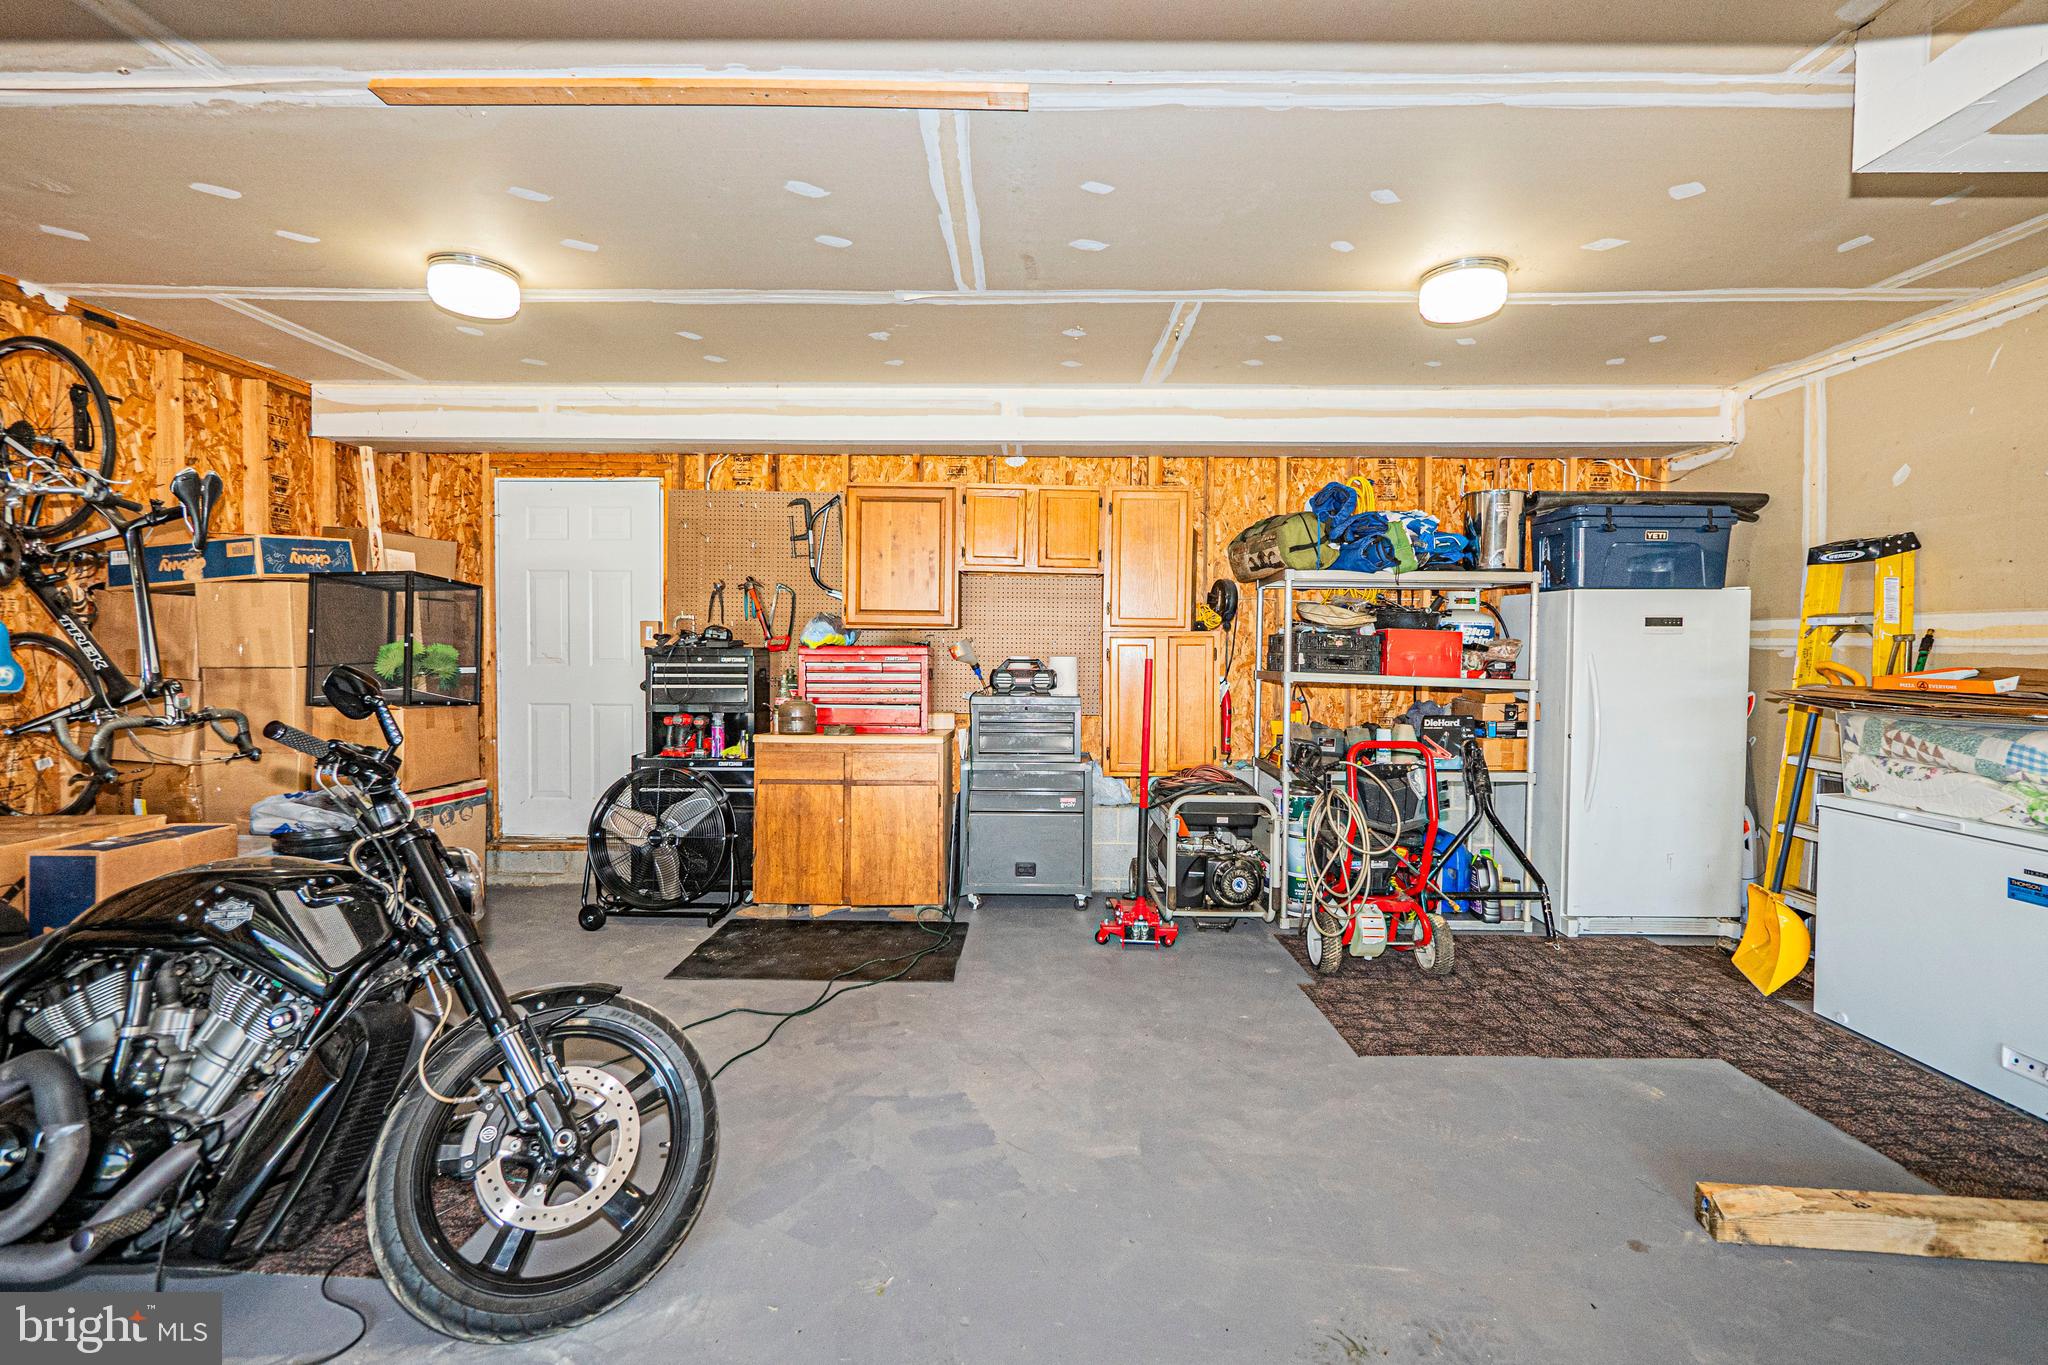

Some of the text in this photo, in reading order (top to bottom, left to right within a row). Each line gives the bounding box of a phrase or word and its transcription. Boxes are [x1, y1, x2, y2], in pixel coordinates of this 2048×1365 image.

[289, 551, 331, 567] chewy
[1828, 552, 1857, 560] WERNER
[59, 614, 109, 670] TREK
[1424, 718, 1460, 727] DieHard
[2011, 879, 2041, 891] THOMSON
[609, 1009, 664, 1038] DUNLOP
